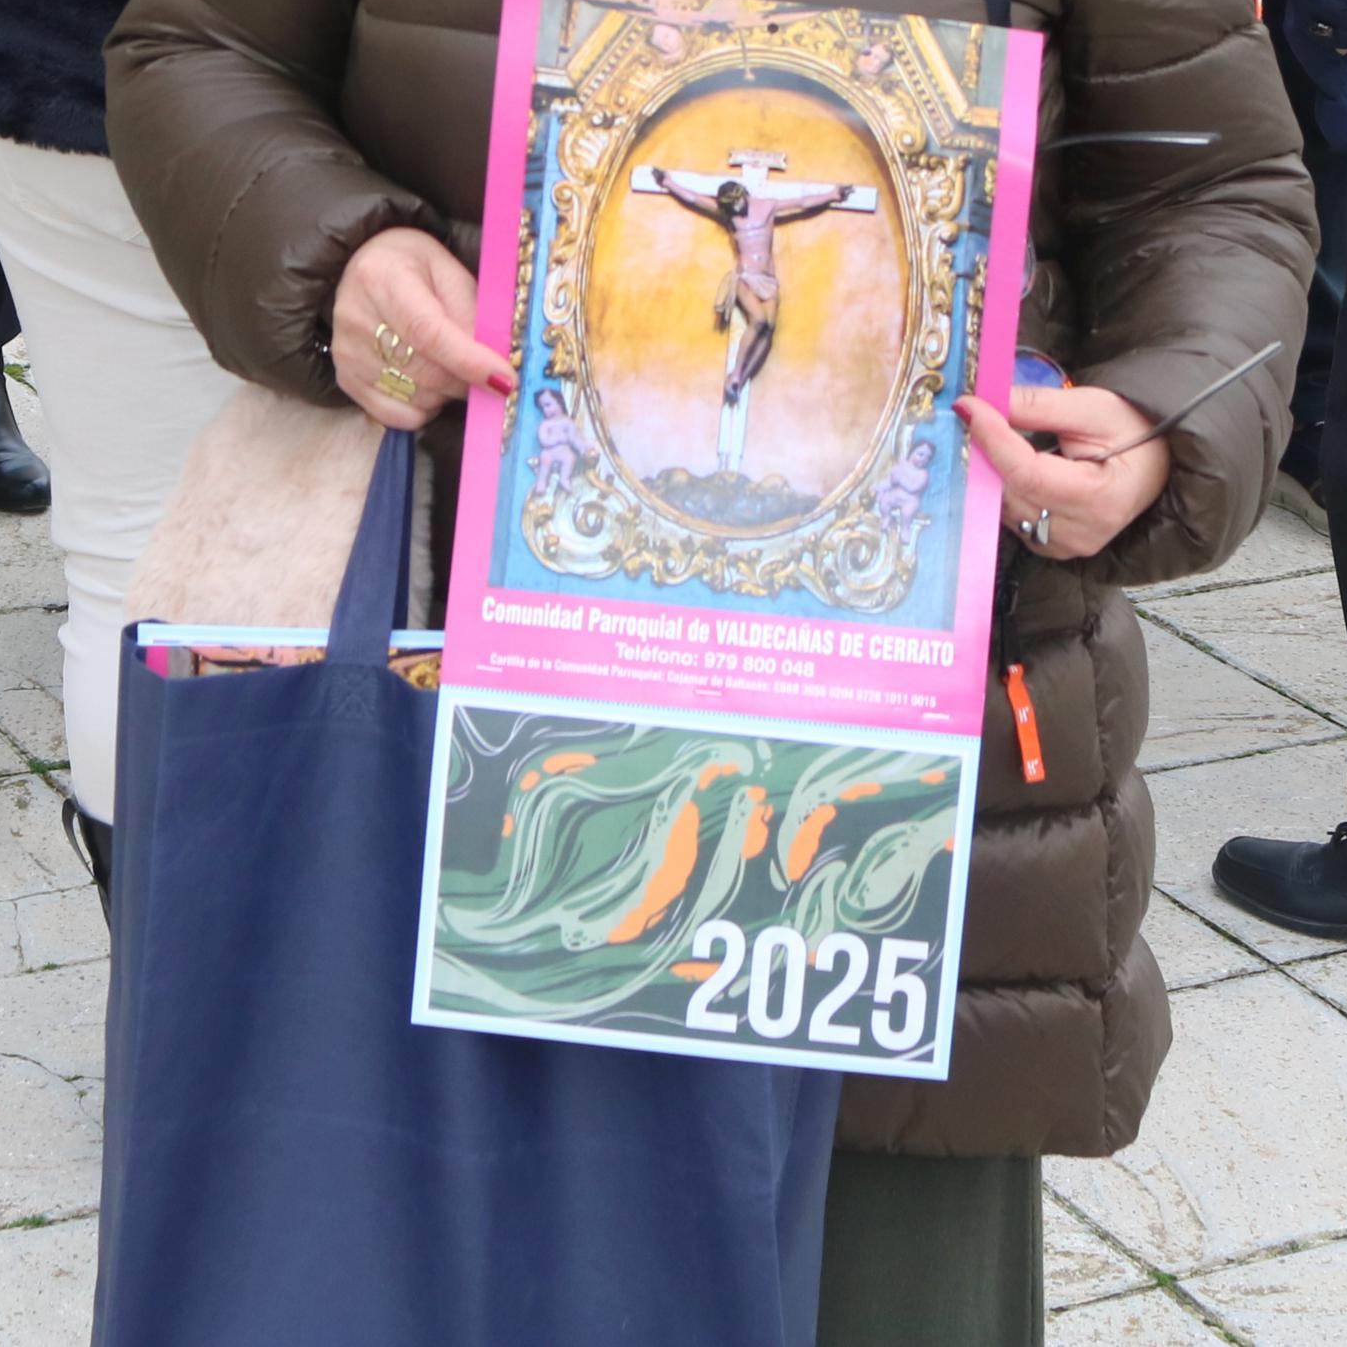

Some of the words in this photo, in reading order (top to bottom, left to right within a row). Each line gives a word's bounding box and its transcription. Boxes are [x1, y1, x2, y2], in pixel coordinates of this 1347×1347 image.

[481, 595, 584, 631] Comunidad
[588, 606, 683, 642] Parroquial
[687, 616, 710, 643] de
[715, 619, 835, 656] VALDECAÑAS
[839, 631, 864, 658] DE
[869, 634, 955, 668] CERRATO
[527, 656, 540, 670] de
[542, 656, 552, 670] la
[554, 657, 609, 676] Comunidad
[710, 675, 723, 687] de
[615, 641, 699, 666] Teléfono:
[704, 651, 738, 670] 979
[742, 655, 777, 675] 800
[781, 659, 815, 678] 048
[685, 919, 929, 1051] 2025
